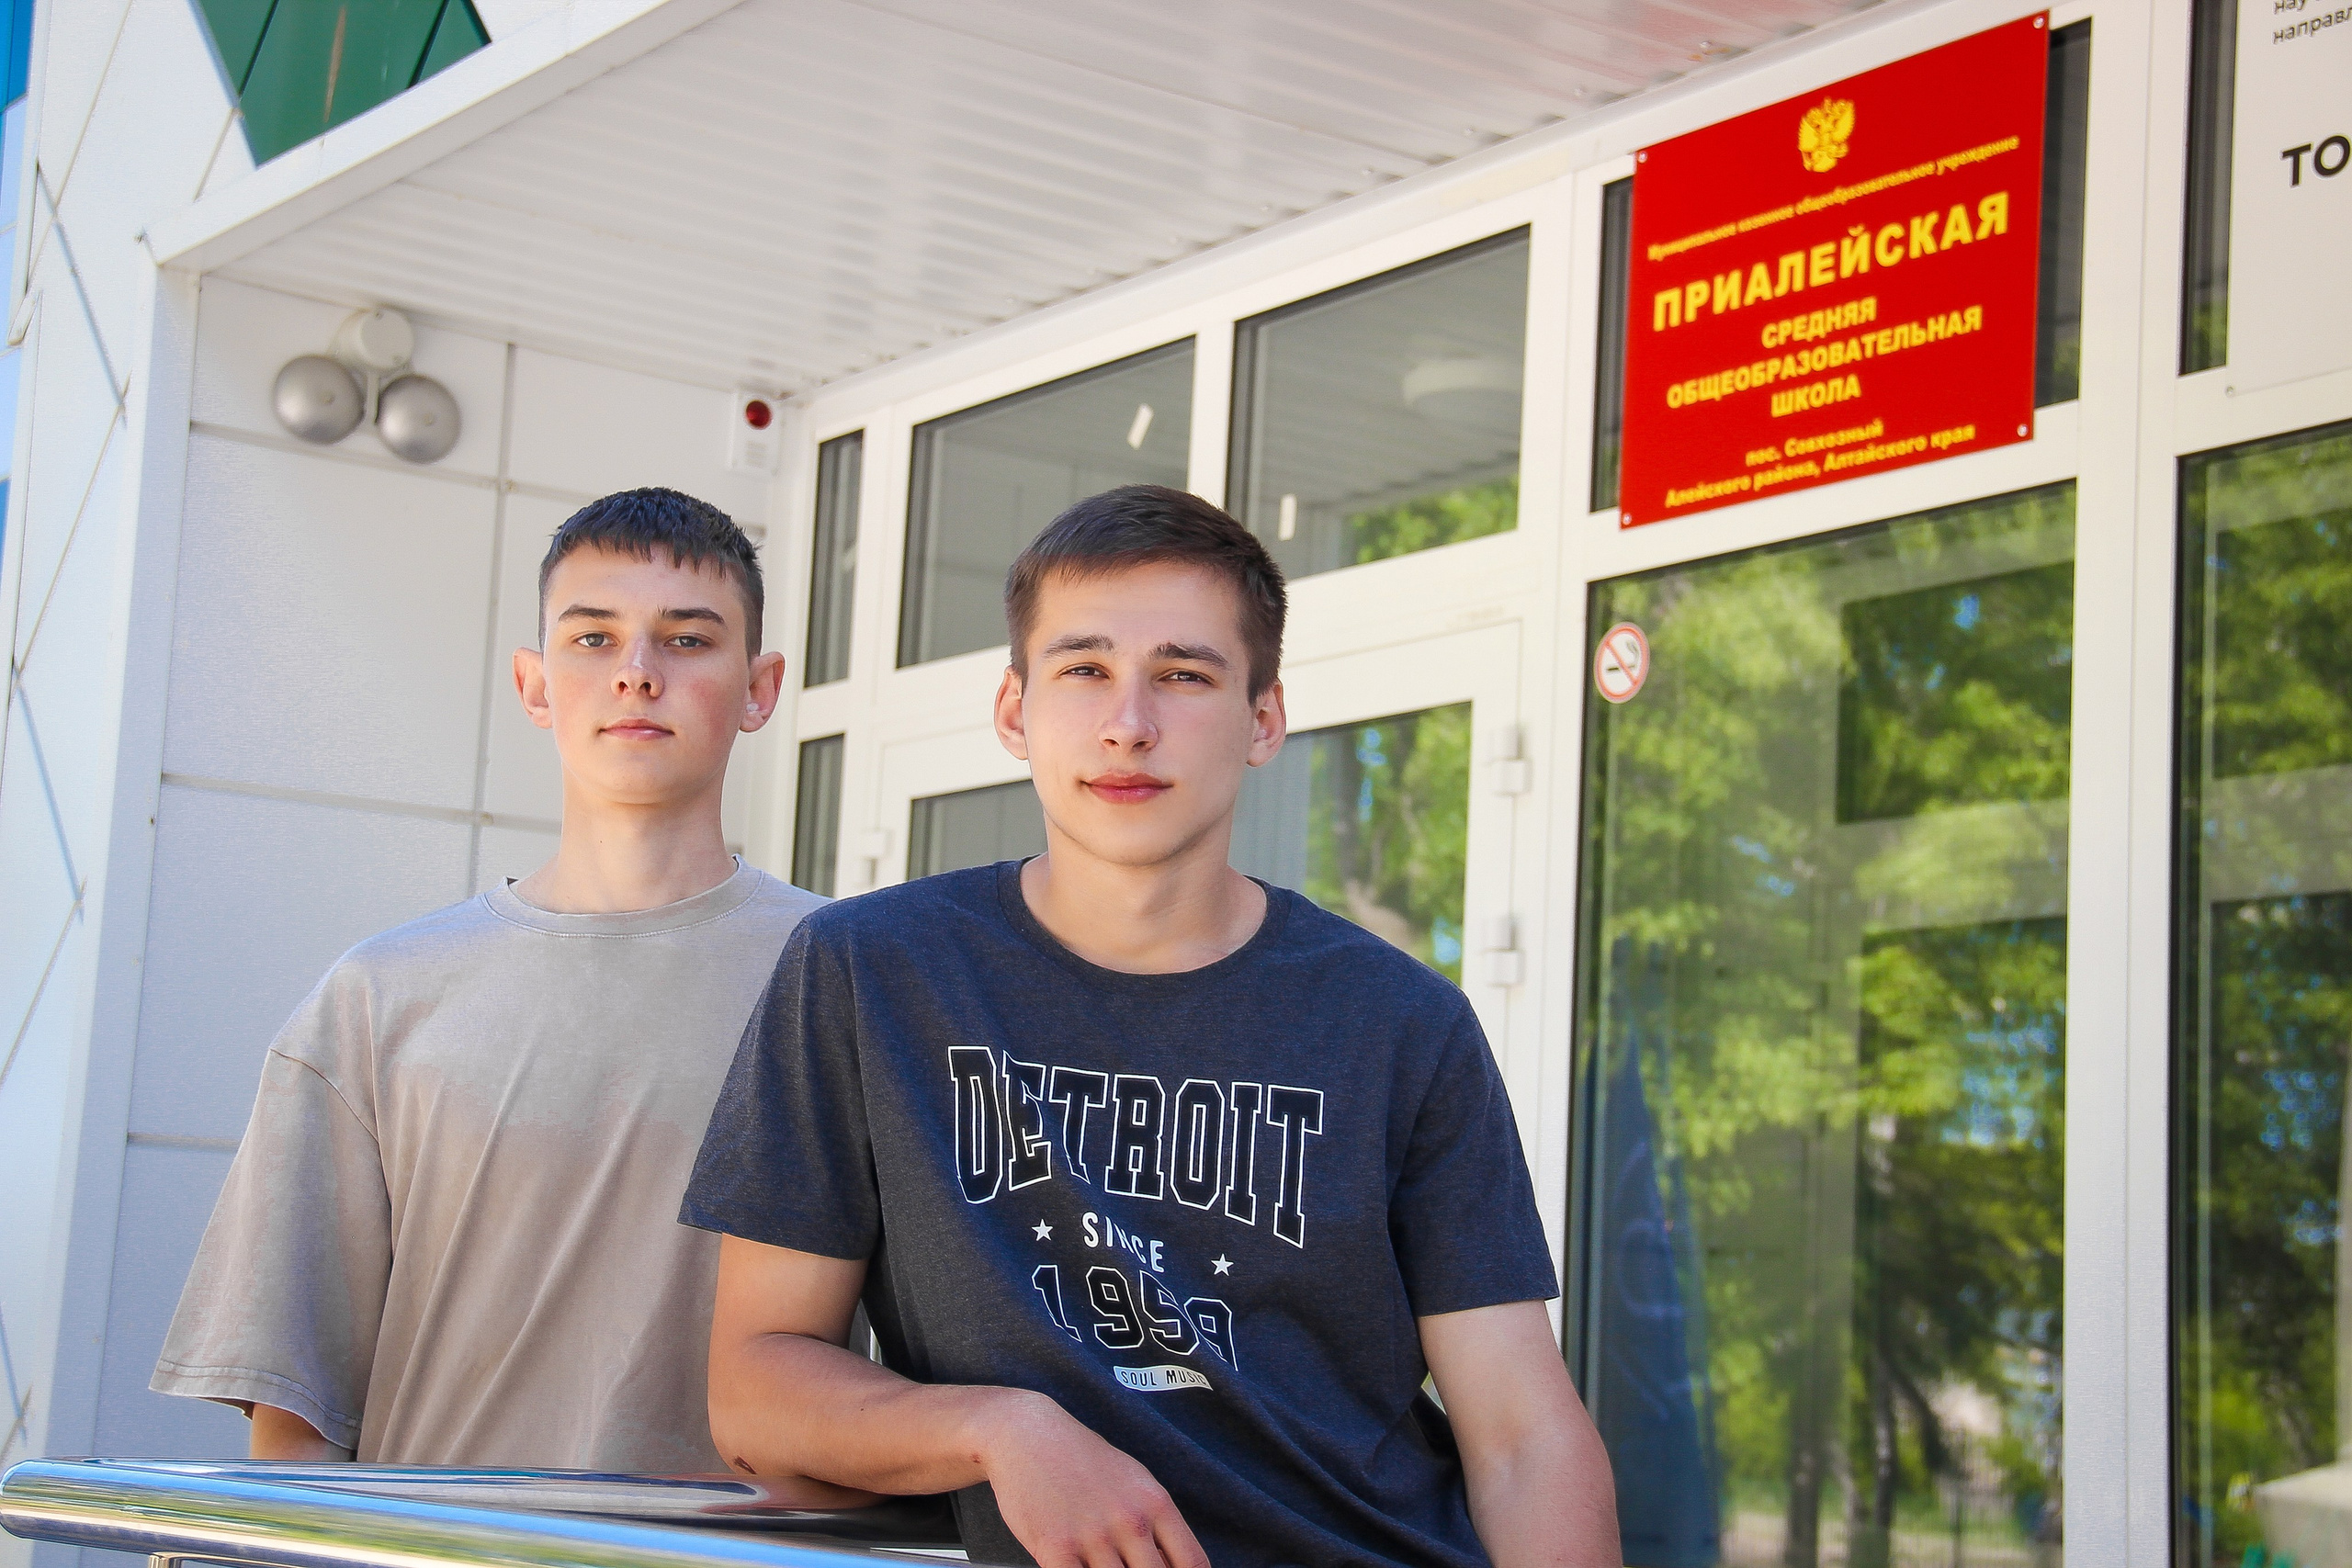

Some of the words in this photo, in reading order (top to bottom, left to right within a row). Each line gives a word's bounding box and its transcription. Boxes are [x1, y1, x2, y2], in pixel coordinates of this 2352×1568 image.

[2281, 135, 2352, 186] ТО
[1653, 191, 2008, 332] ПРИАЛЕЙСКАЯ
[1761, 296, 1877, 349] СРЕДНЯЯ
[1667, 305, 1983, 409] ОБЩЕОБРАЗОВАТЕЛЬНАЯ
[1770, 374, 1861, 418] ШКОЛА
[1665, 475, 1752, 508] Алейского
[1753, 460, 1821, 491] района,
[1824, 435, 1928, 472] Алтайского
[1930, 424, 1976, 450] края
[1746, 446, 1781, 467] пос.
[1784, 418, 1883, 457] Совхозный
[947, 1045, 1325, 1249] DETROIT
[1082, 1212, 1165, 1273] SINCE
[1031, 1264, 1239, 1372] 1959
[1121, 1371, 1158, 1386] SOUL
[1165, 1370, 1206, 1385] MUSIC
